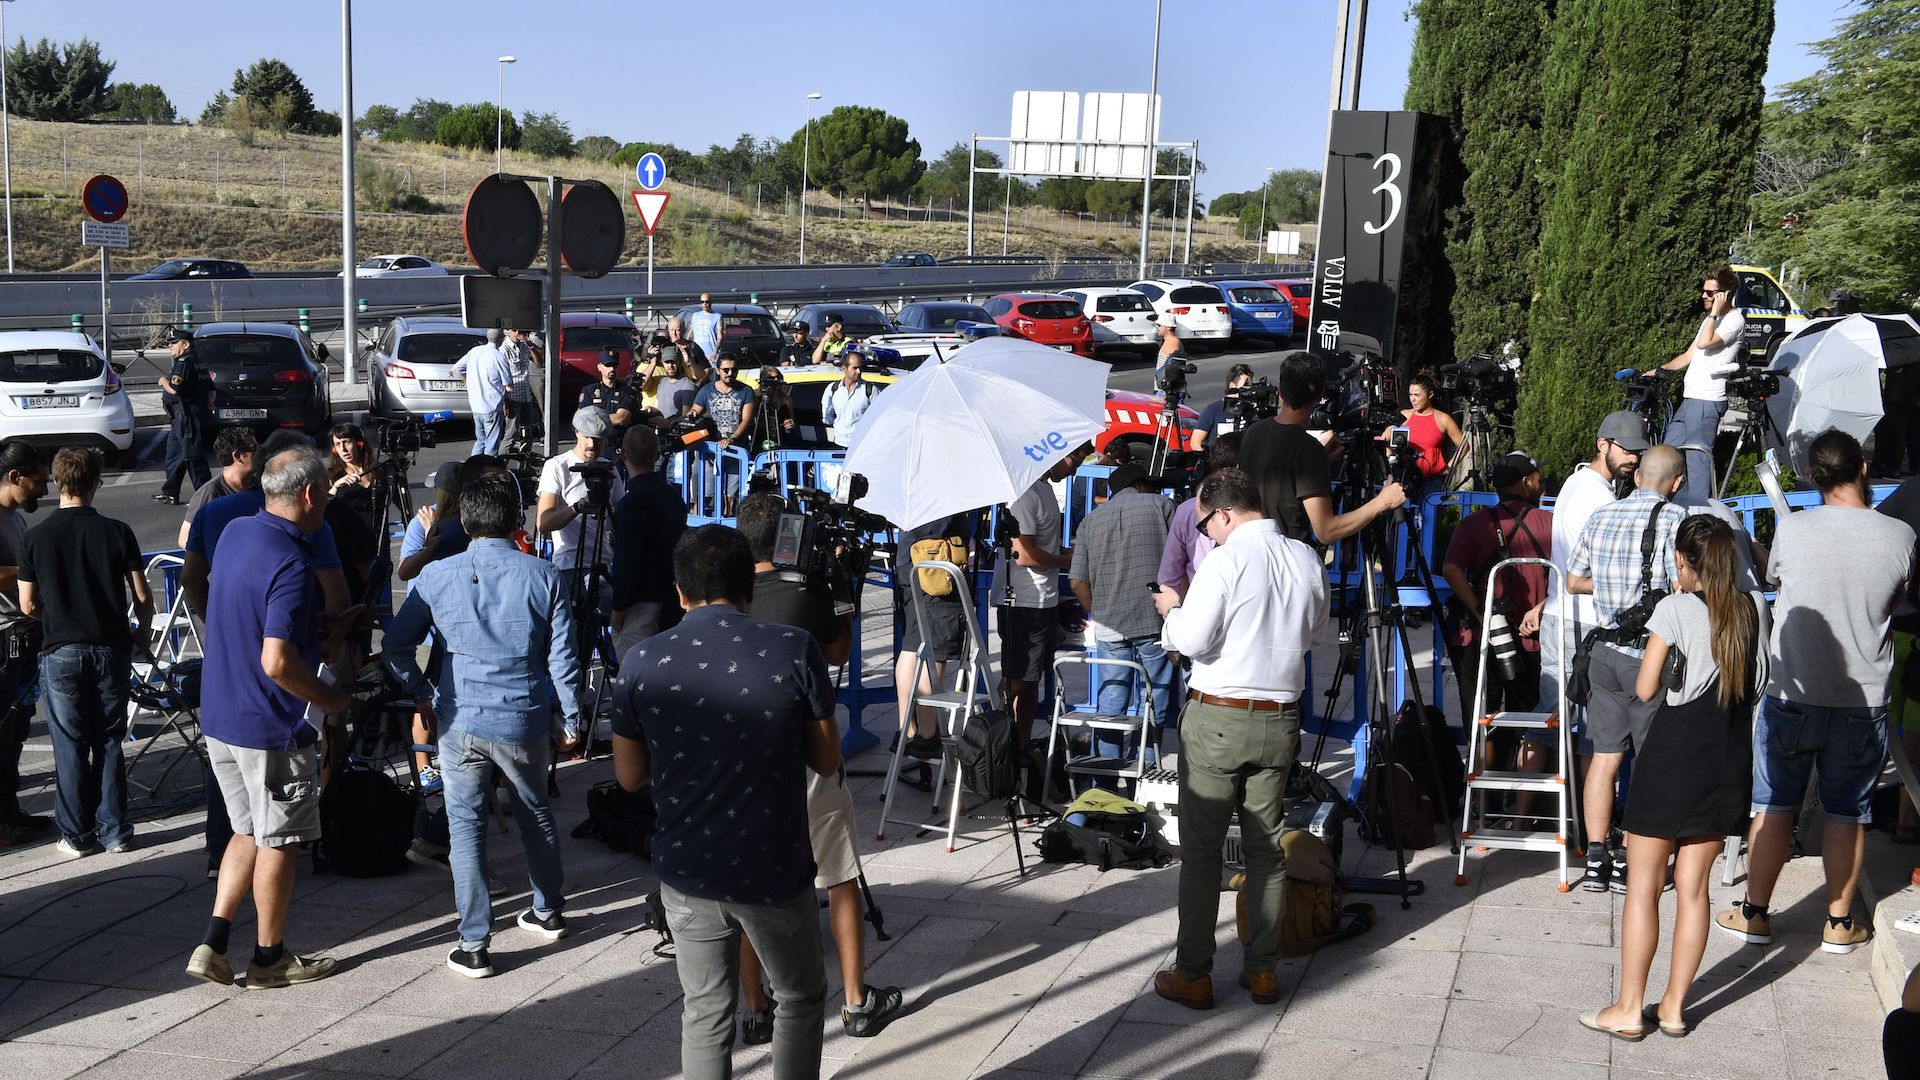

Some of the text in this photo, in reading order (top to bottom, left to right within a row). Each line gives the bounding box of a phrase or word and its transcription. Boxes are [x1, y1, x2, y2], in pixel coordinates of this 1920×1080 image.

[1363, 152, 1402, 235] 3
[1322, 256, 1346, 309] ATICA
[434, 381, 467, 389] 5261 HR
[29, 397, 53, 406] 8857
[1023, 431, 1068, 462] tve
